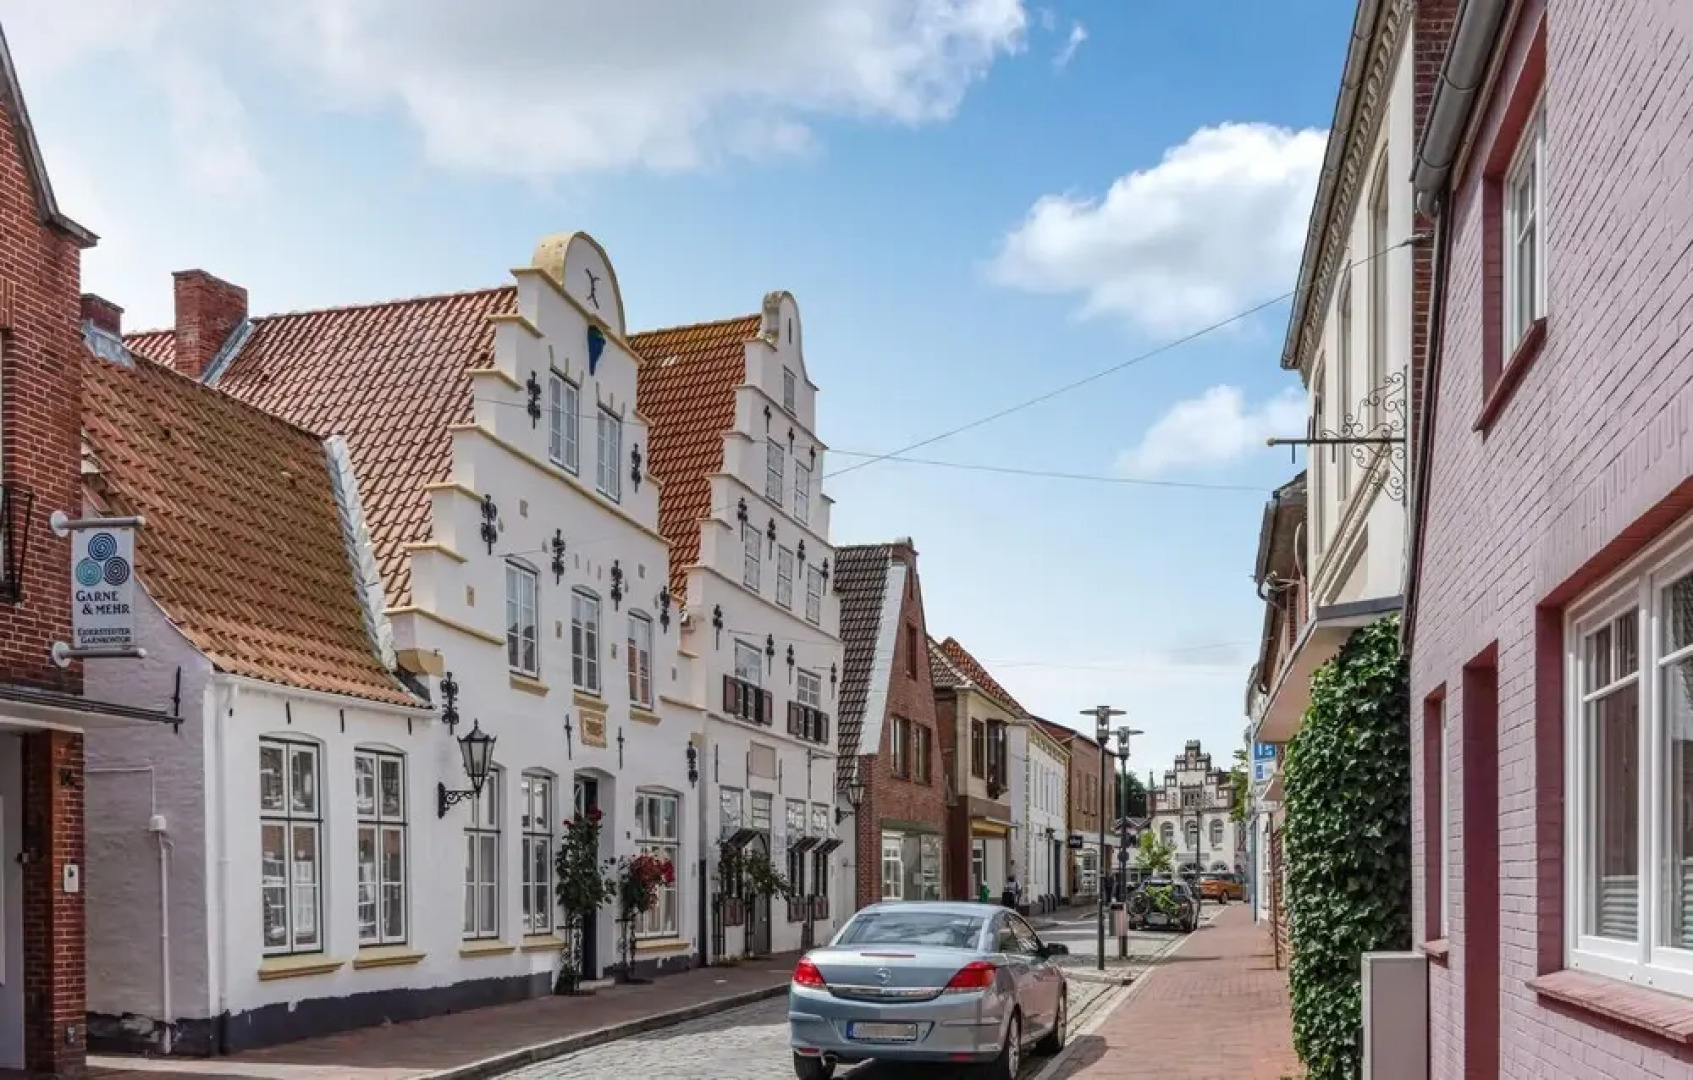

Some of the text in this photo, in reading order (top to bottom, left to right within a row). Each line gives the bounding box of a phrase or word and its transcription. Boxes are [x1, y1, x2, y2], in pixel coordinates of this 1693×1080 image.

[76, 590, 119, 602] GARNE
[82, 603, 130, 615] & MEHR
